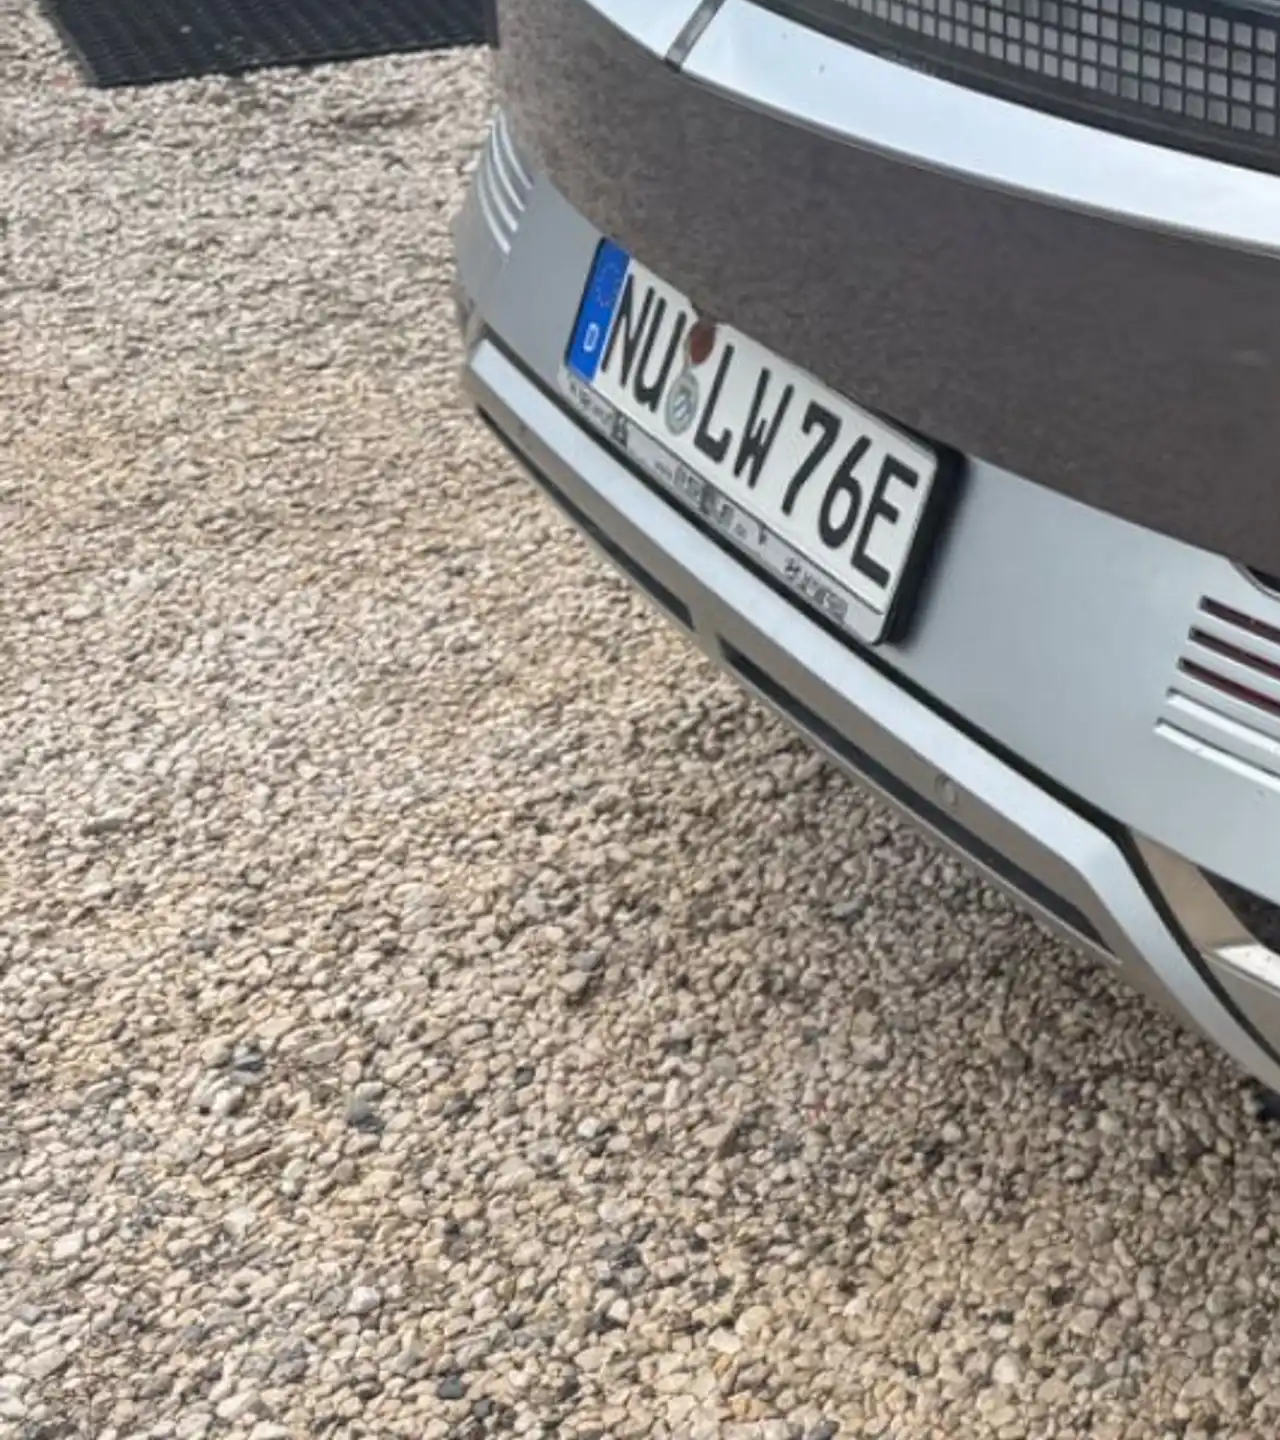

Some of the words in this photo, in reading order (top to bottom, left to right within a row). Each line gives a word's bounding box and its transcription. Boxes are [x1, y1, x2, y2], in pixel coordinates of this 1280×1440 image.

[601, 273, 688, 413] NU
[693, 343, 795, 490] LW
[781, 399, 919, 590] 76E
